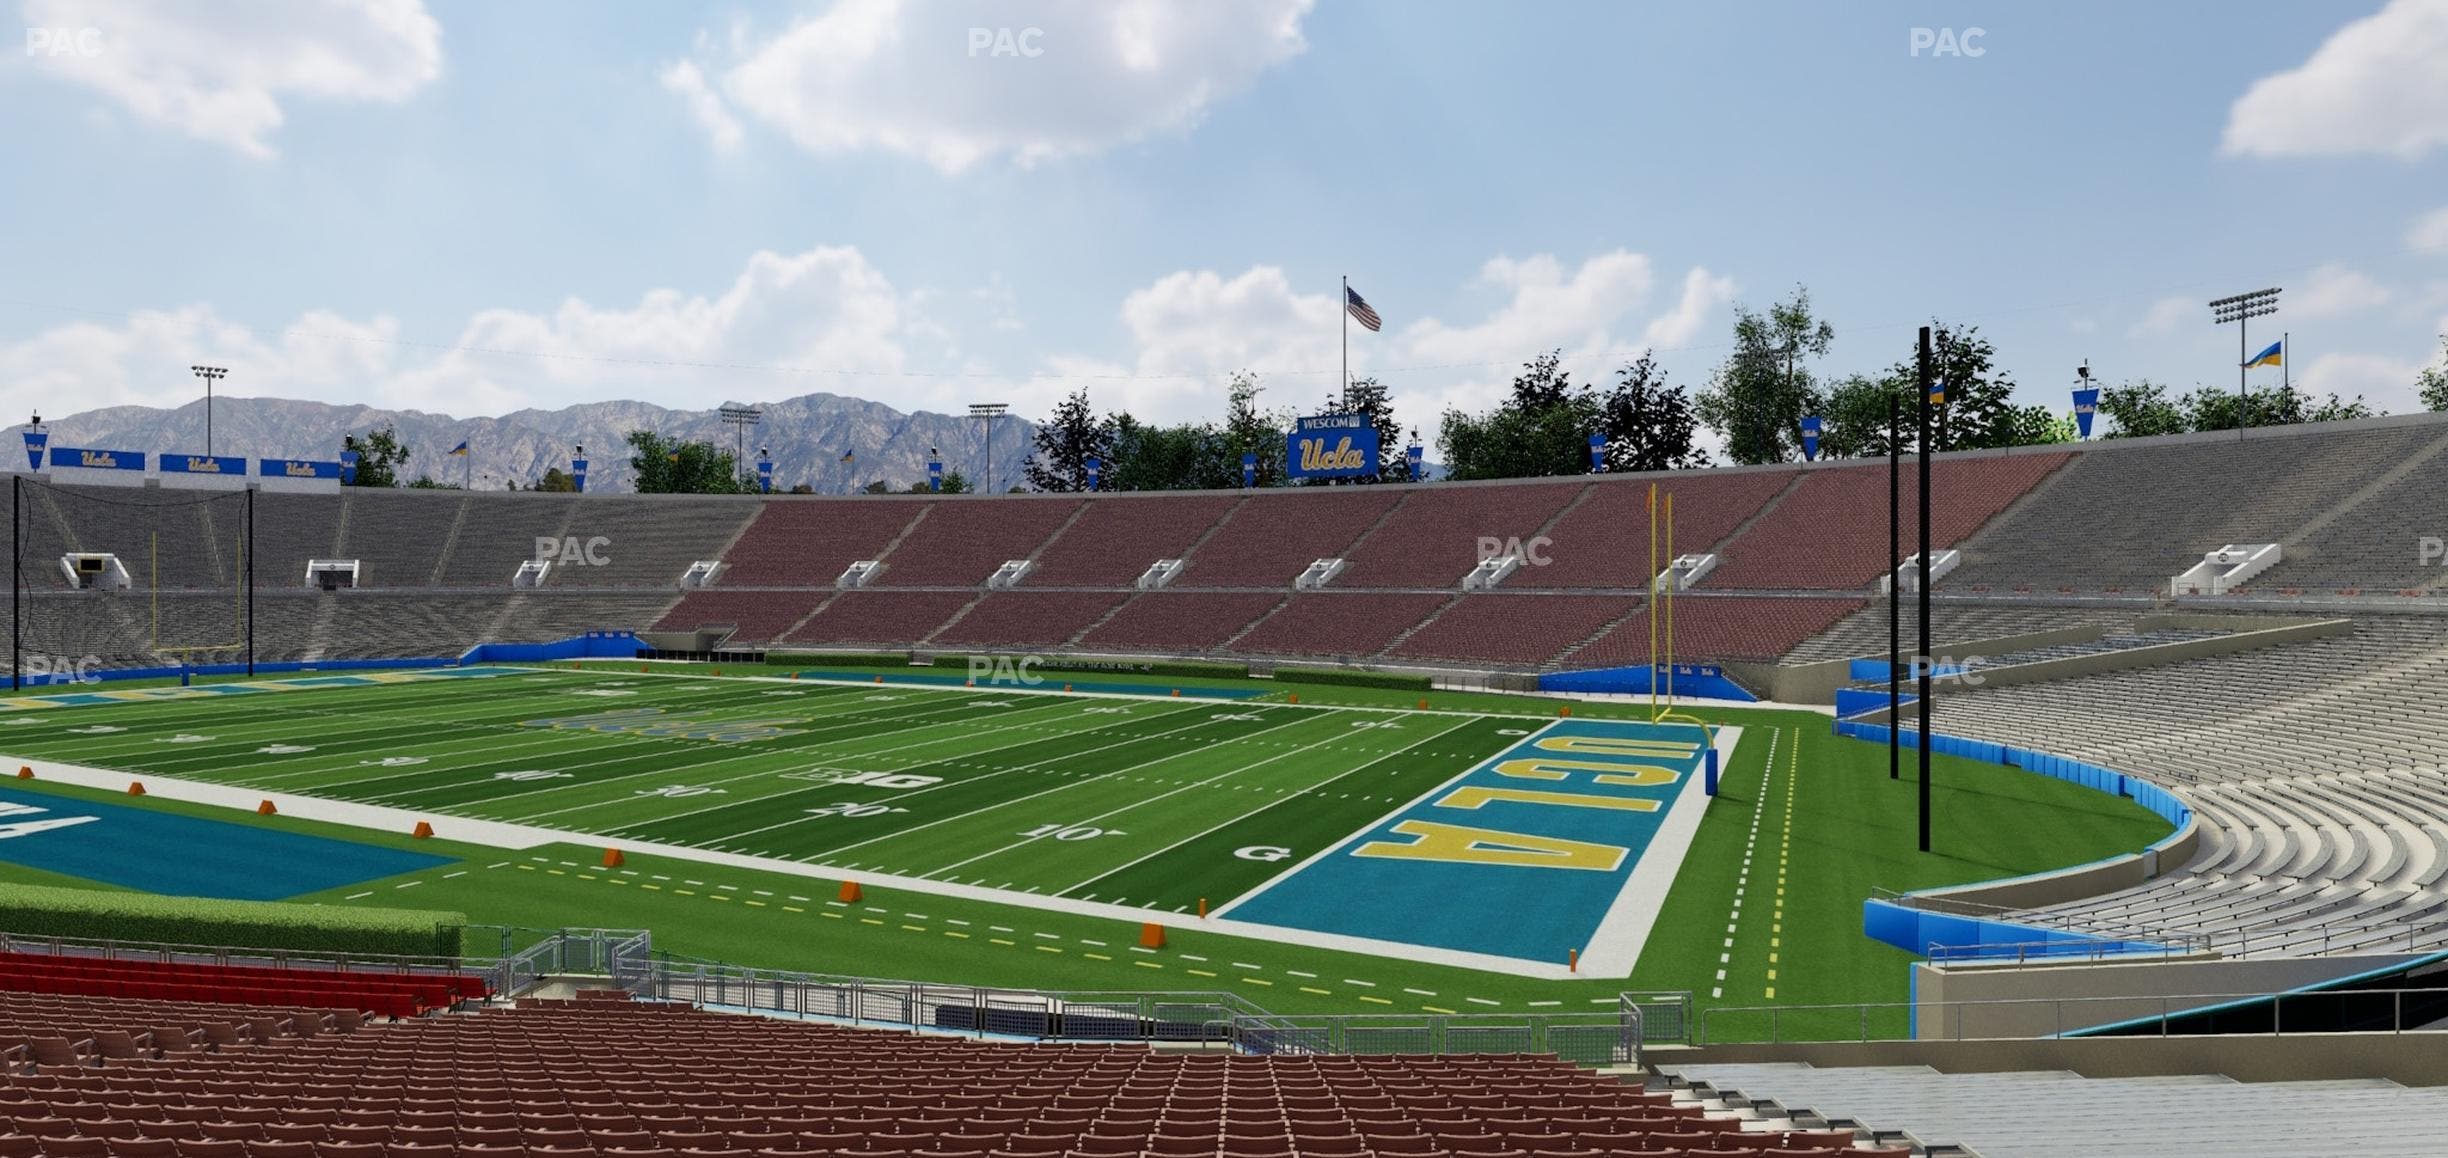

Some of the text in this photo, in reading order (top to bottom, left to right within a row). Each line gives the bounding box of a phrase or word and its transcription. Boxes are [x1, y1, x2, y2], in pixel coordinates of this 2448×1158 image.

[1304, 417, 1349, 429] WESCOM
[1299, 436, 1366, 471] Ucla
[803, 802, 890, 817] 20
[1350, 735, 1701, 871] UCLA
[1016, 824, 1103, 840] 10
[1233, 846, 1291, 862] G
